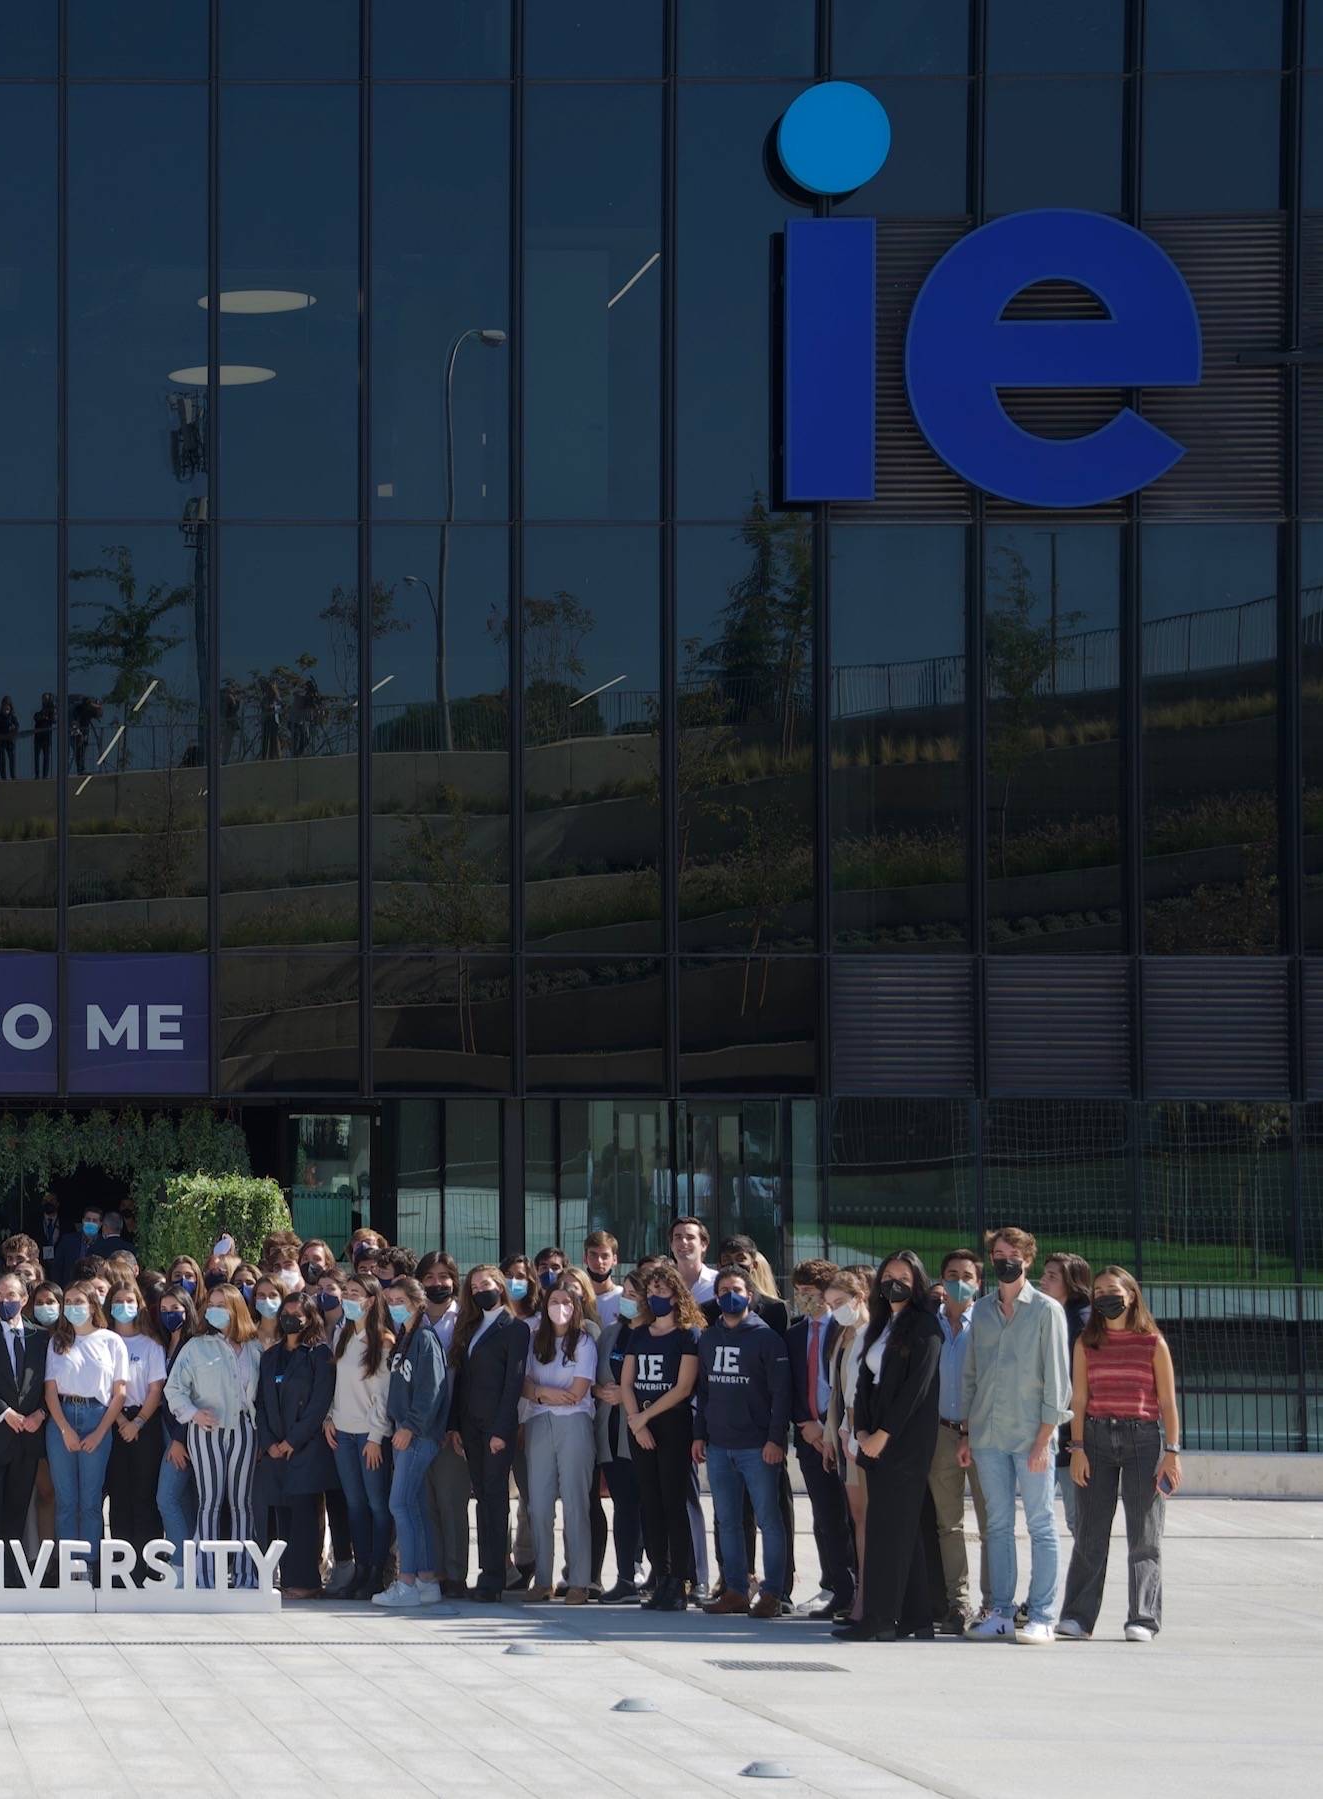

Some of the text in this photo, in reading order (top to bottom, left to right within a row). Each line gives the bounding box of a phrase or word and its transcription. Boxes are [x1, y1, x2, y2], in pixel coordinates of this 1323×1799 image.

[780, 81, 1203, 508] ie
[637, 1354, 664, 1381] IE
[712, 1345, 741, 1374] IE
[633, 1382, 672, 1391] NIVERSITY
[708, 1374, 750, 1384] NIVERSITY
